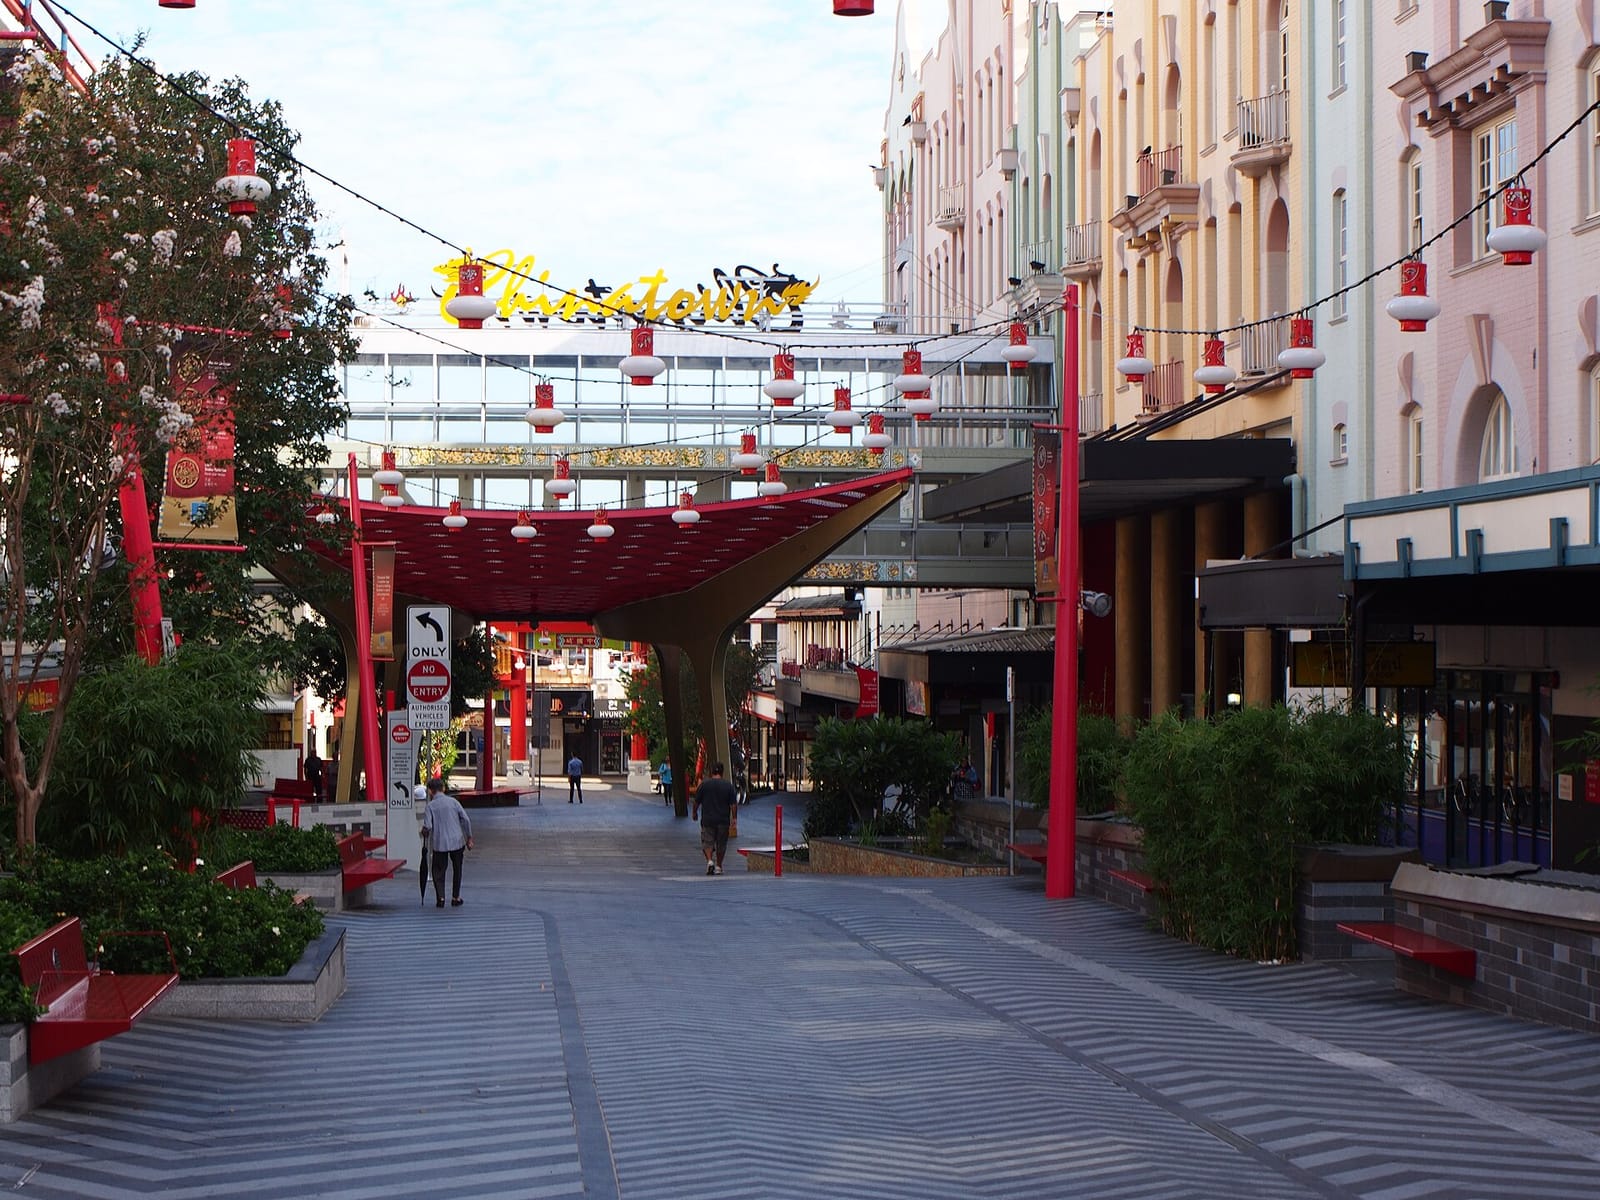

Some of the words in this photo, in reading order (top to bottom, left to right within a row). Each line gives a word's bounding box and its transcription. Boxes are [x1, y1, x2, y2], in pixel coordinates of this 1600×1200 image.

[412, 647, 447, 657] ONLY
[422, 665, 435, 674] NO
[413, 687, 445, 697] ENTRY
[411, 704, 448, 712] AUTHORISED
[415, 712, 444, 720] VEHICLES
[414, 720, 445, 728] EXCEPTED
